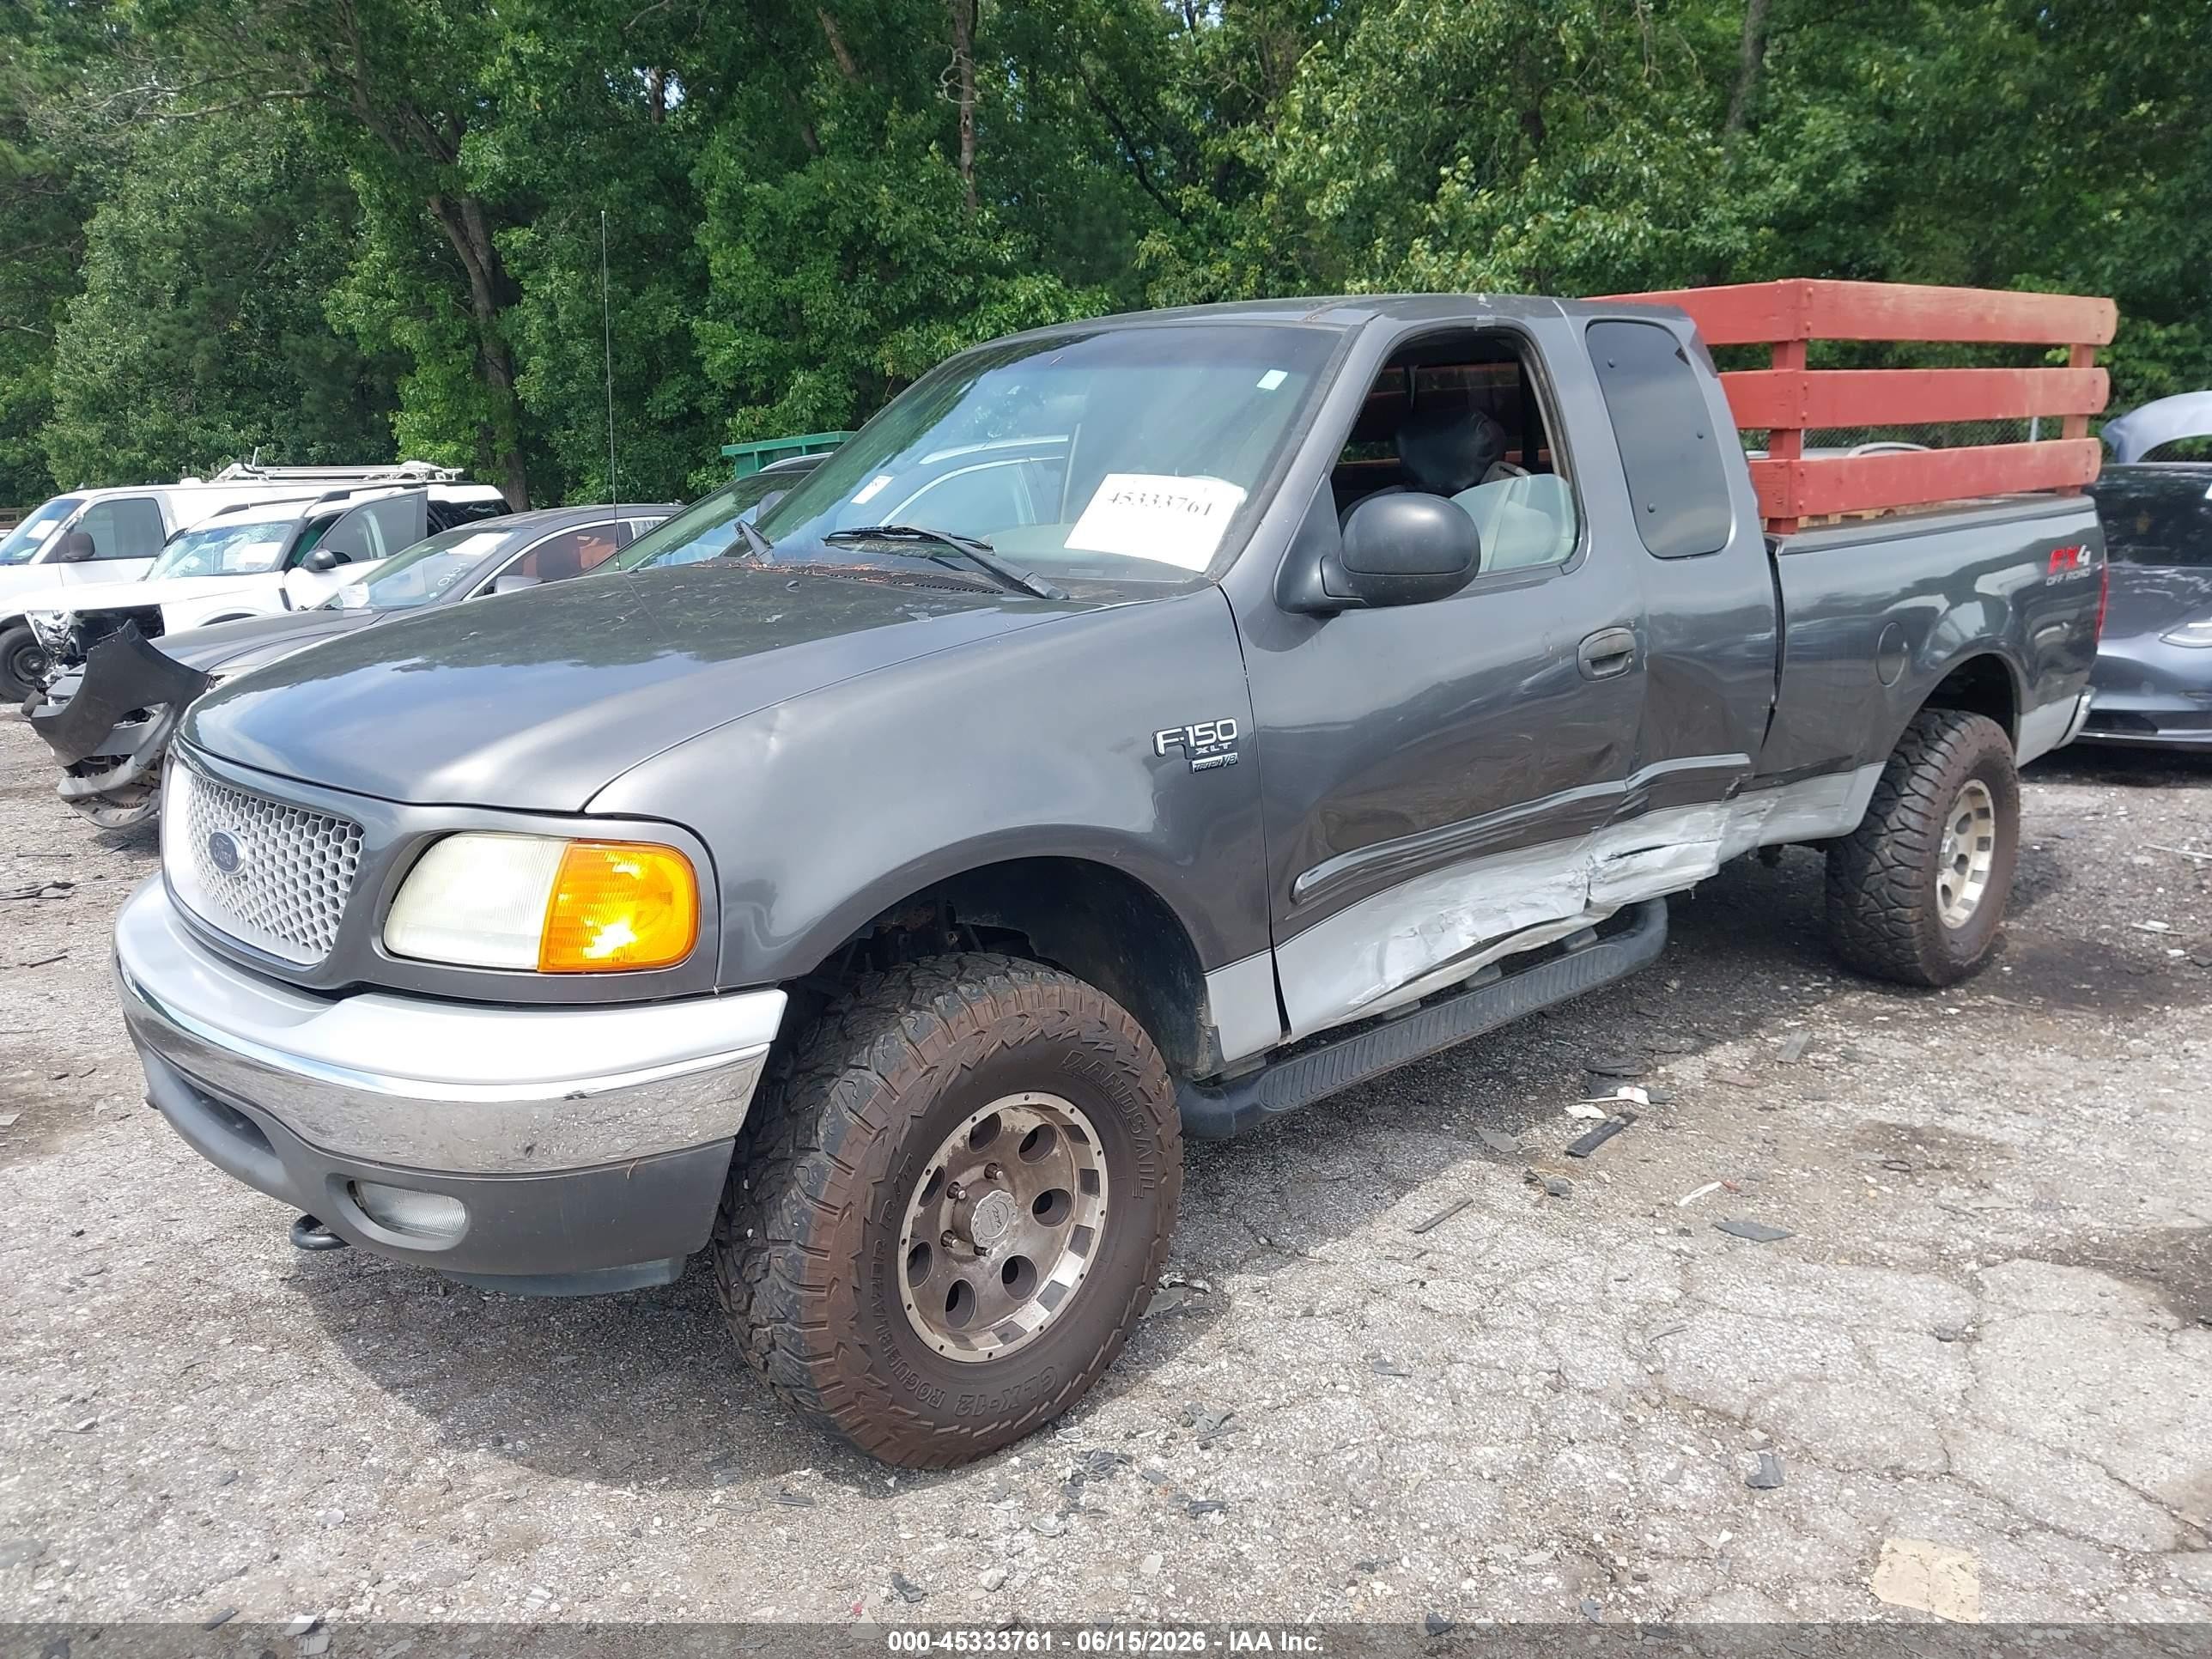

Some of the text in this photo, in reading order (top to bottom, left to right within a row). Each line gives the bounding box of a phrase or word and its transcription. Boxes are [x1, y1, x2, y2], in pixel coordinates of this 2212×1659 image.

[1108, 490, 1213, 516] 45333761
[2047, 544, 2092, 575] FX4
[2045, 567, 2092, 586] OFF ROAD
[1194, 741, 1232, 756] XLT
[215, 836, 233, 866] Ford
[1060, 1049, 1156, 1200] LANDSAIL
